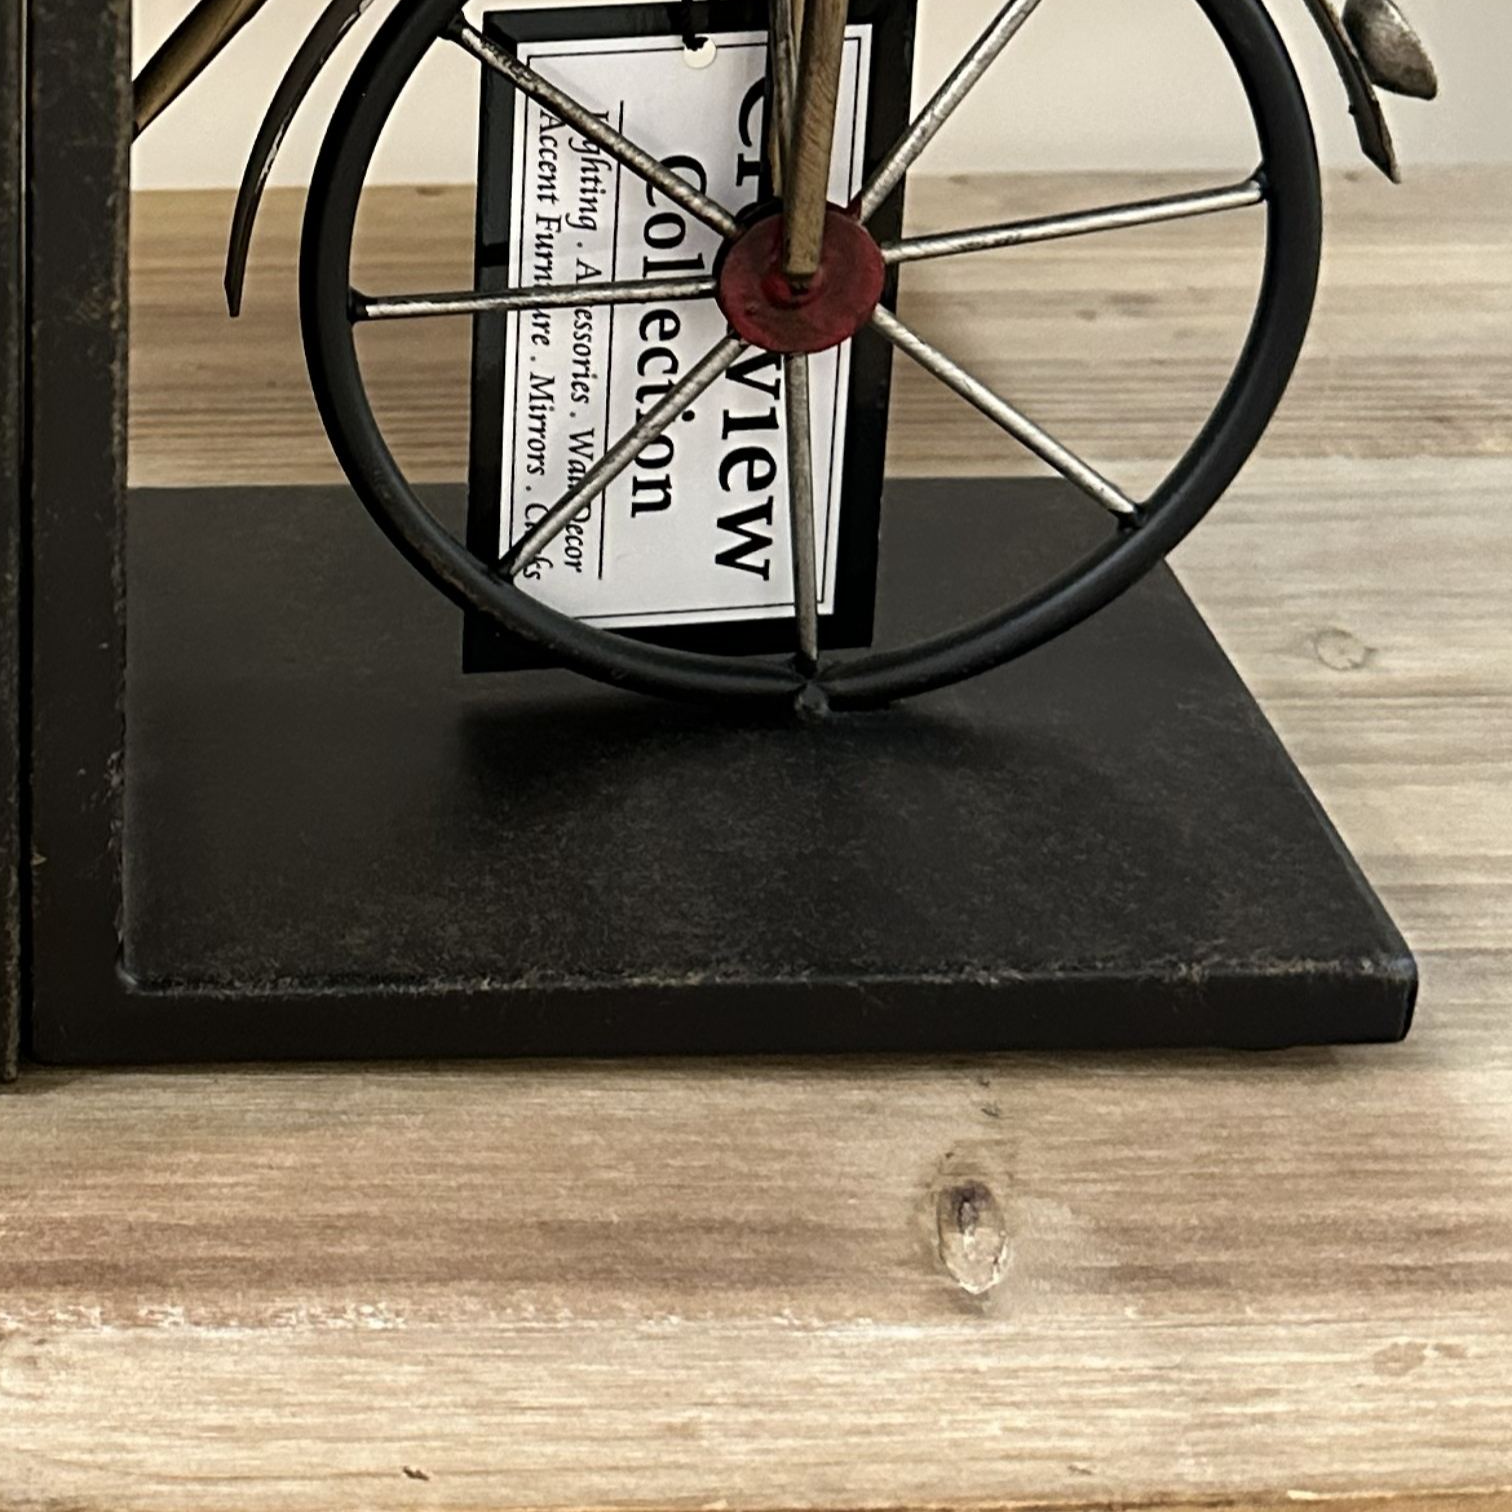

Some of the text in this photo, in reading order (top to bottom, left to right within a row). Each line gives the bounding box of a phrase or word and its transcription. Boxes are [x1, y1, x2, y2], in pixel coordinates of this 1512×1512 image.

[566, 110, 612, 231] ghting
[523, 109, 566, 580] Accent Furnure Mirrors Cks
[571, 258, 602, 404] Aessories
[631, 155, 707, 518] Colecton
[567, 428, 595, 491] Wa
